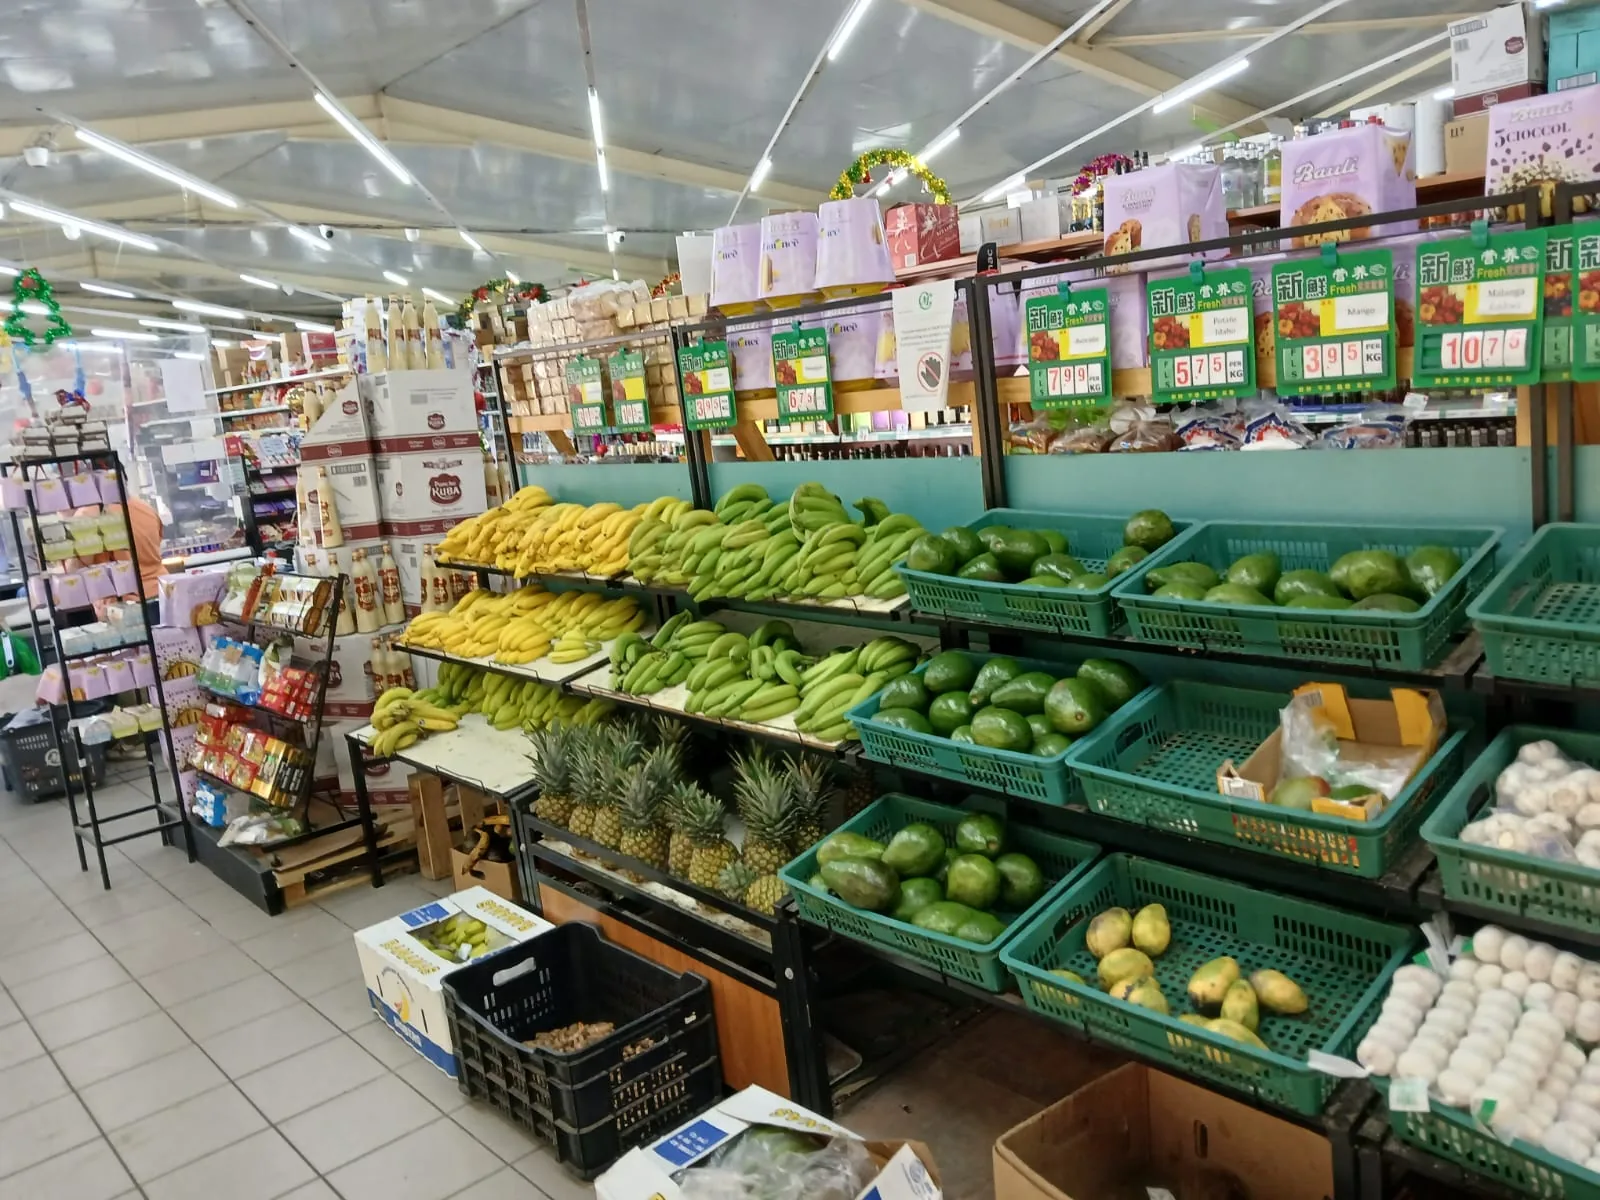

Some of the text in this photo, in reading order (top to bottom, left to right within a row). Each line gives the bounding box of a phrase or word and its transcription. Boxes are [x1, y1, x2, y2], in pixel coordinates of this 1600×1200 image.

[1293, 157, 1359, 185] Bauli
[1477, 268, 1506, 279] Fresh
[1330, 284, 1357, 295] Fresh
[1198, 299, 1221, 310] Fresh
[1366, 353, 1381, 362] KG
[1230, 370, 1243, 378] KG
[432, 487, 460, 499] KUBA
